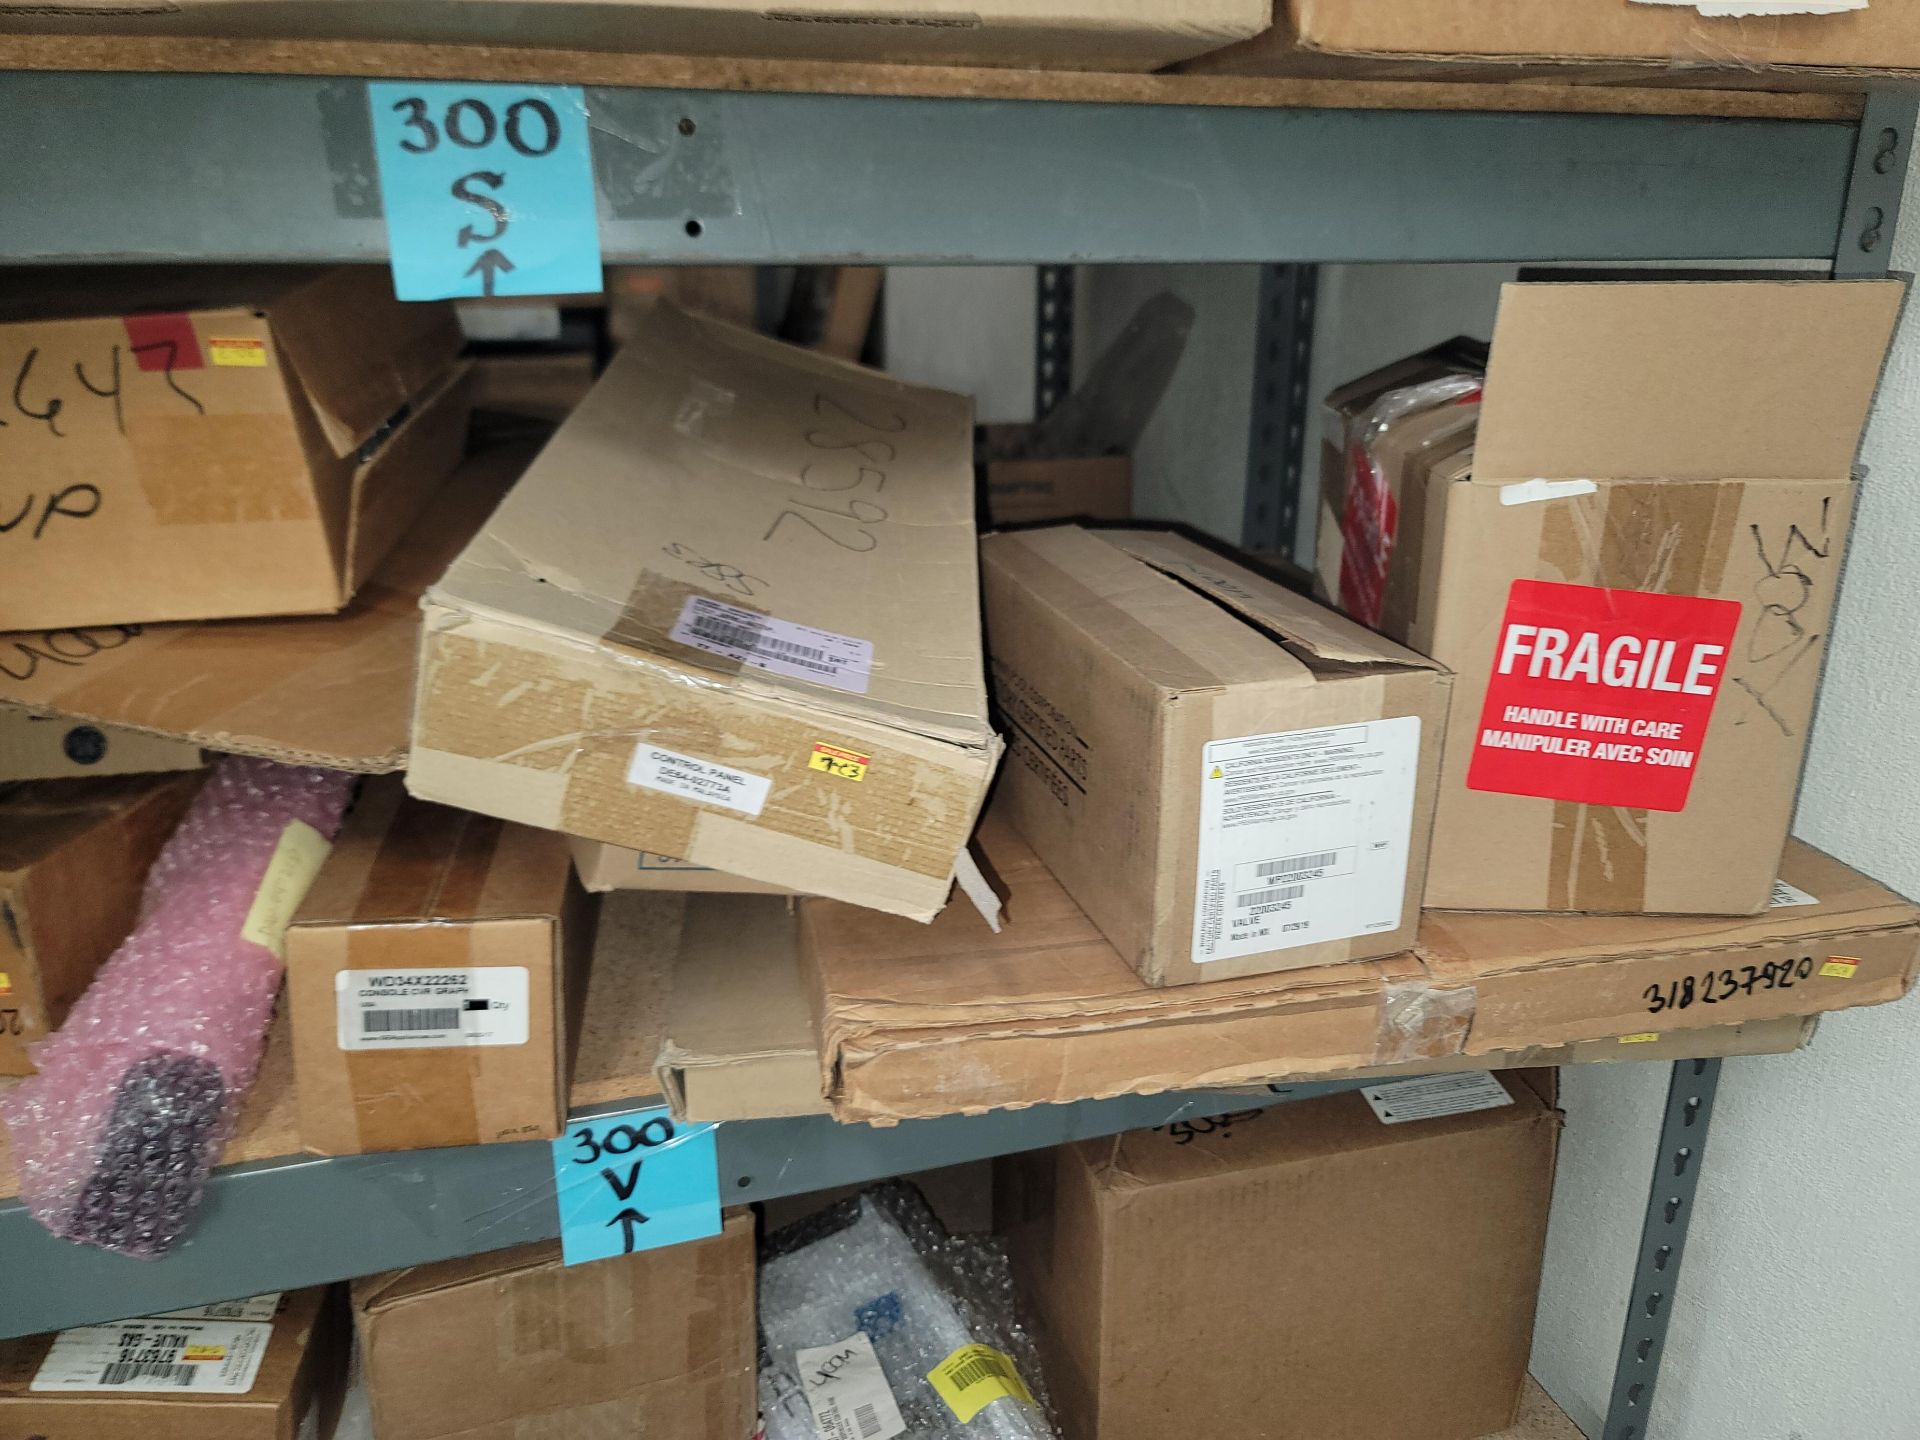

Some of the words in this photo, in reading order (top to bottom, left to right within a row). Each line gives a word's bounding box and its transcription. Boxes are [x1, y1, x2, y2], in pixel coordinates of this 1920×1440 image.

[393, 97, 561, 157] 300
[451, 170, 510, 248] S
[0, 343, 205, 437] 647
[1498, 623, 1725, 696] FRAGILE
[1504, 705, 1578, 730] HANDLE
[1580, 713, 1627, 734] WITH
[1630, 719, 1683, 740] CARE
[651, 751, 707, 775] CONTROL
[709, 768, 747, 786] PANEL
[1481, 729, 1591, 758] MANIPULER
[1591, 742, 1644, 763] AVEC
[1645, 747, 1694, 768] SOIN
[1232, 916, 1260, 928] VALVE
[359, 988, 408, 997] CONSOLE
[1643, 957, 1813, 1013] 318237920
[572, 1116, 675, 1164] 300
[602, 1160, 642, 1201] V
